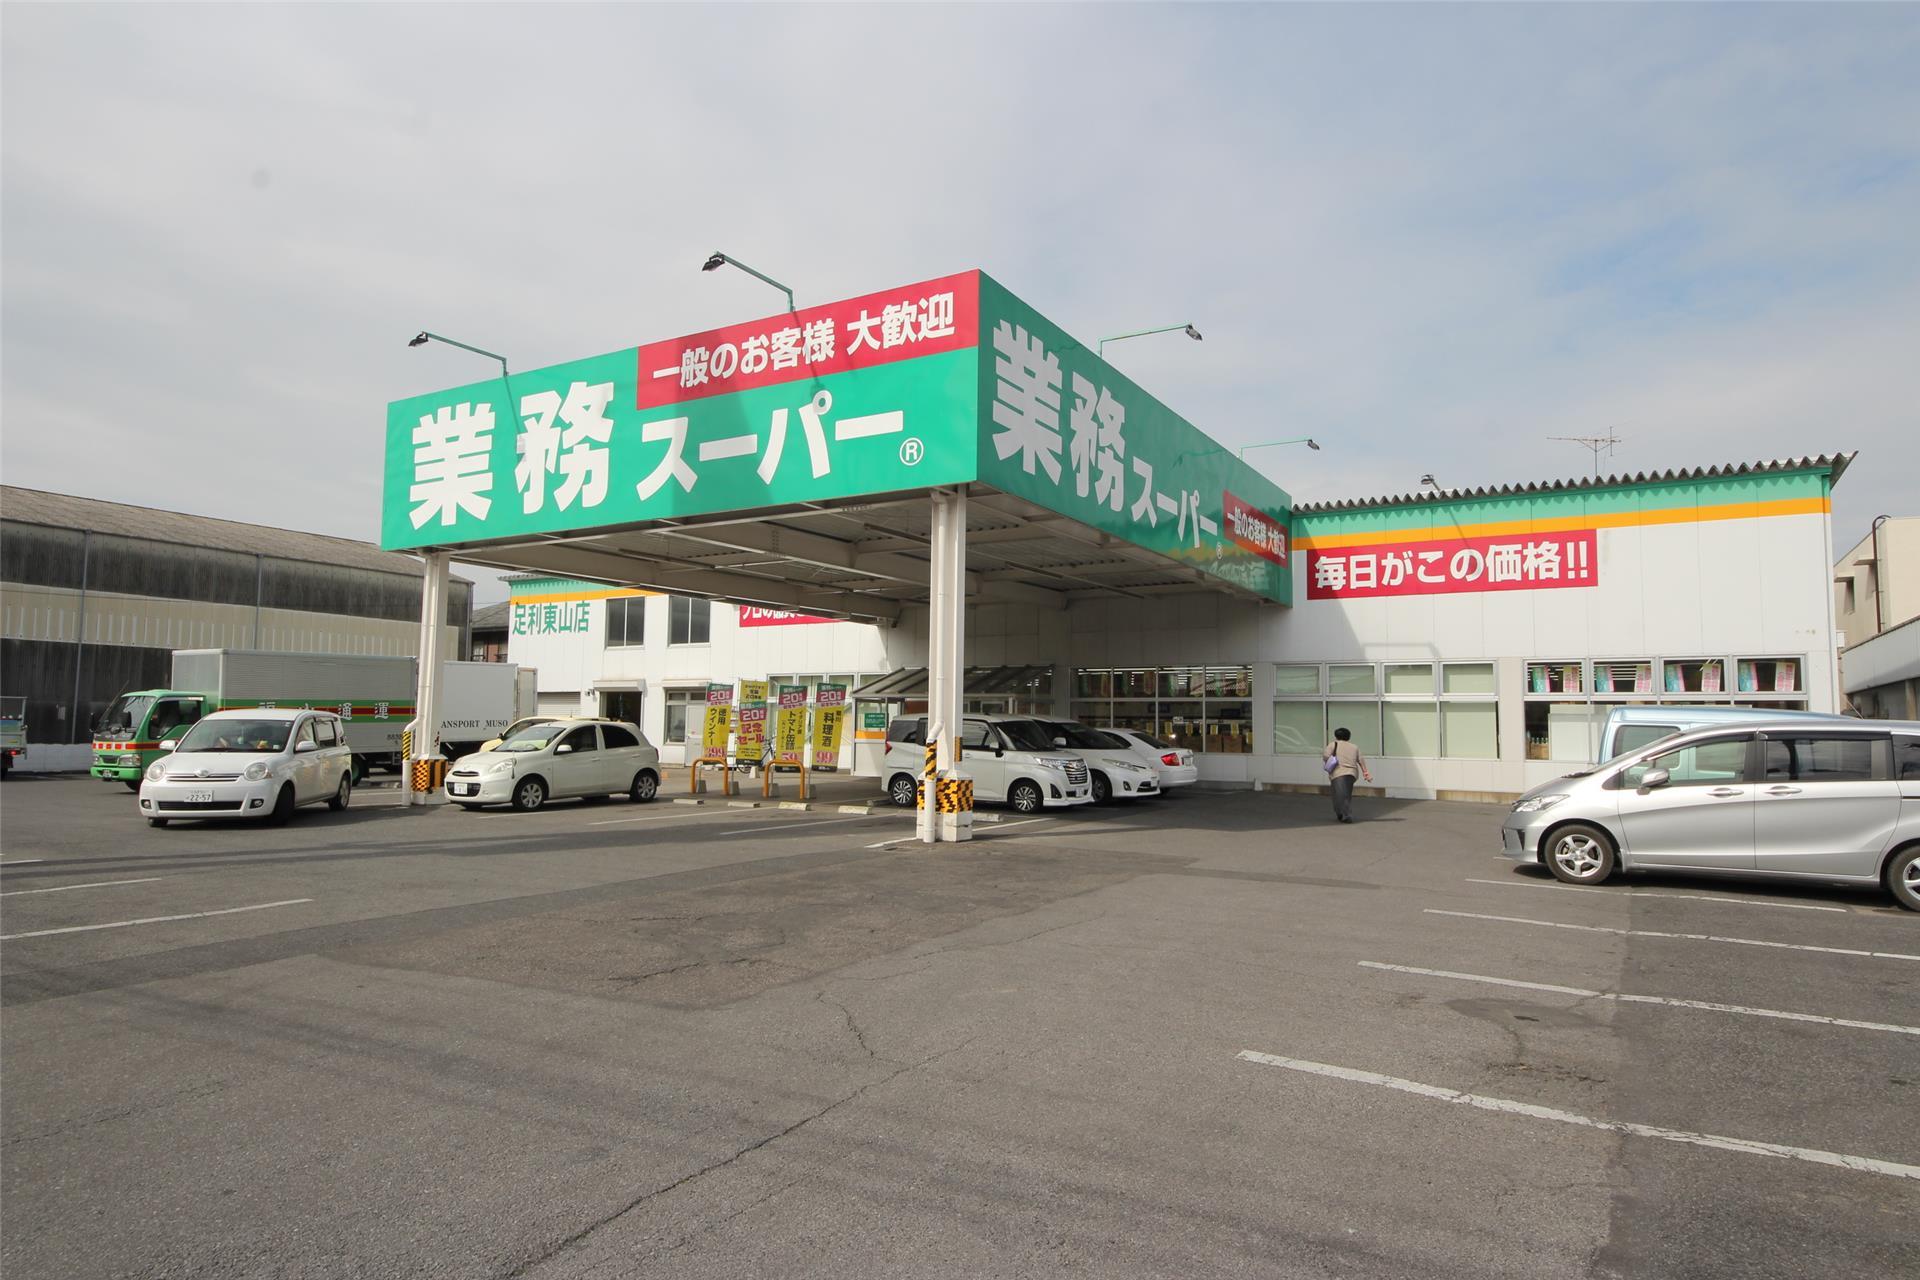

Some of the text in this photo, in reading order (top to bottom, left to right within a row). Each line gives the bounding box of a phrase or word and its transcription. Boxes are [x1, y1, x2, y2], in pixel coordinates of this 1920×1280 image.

[653, 291, 955, 388] 一般のお客様 大歓迎
[992, 319, 1218, 548] 業務スーパー
[409, 381, 903, 530] 業務スーパー
[1314, 541, 1589, 591] 毎日がこの価格!!
[512, 601, 591, 635] 足利東山店
[441, 719, 508, 729] ANSPORT MUSO
[737, 733, 765, 745] セール
[741, 722, 763, 733] 記念
